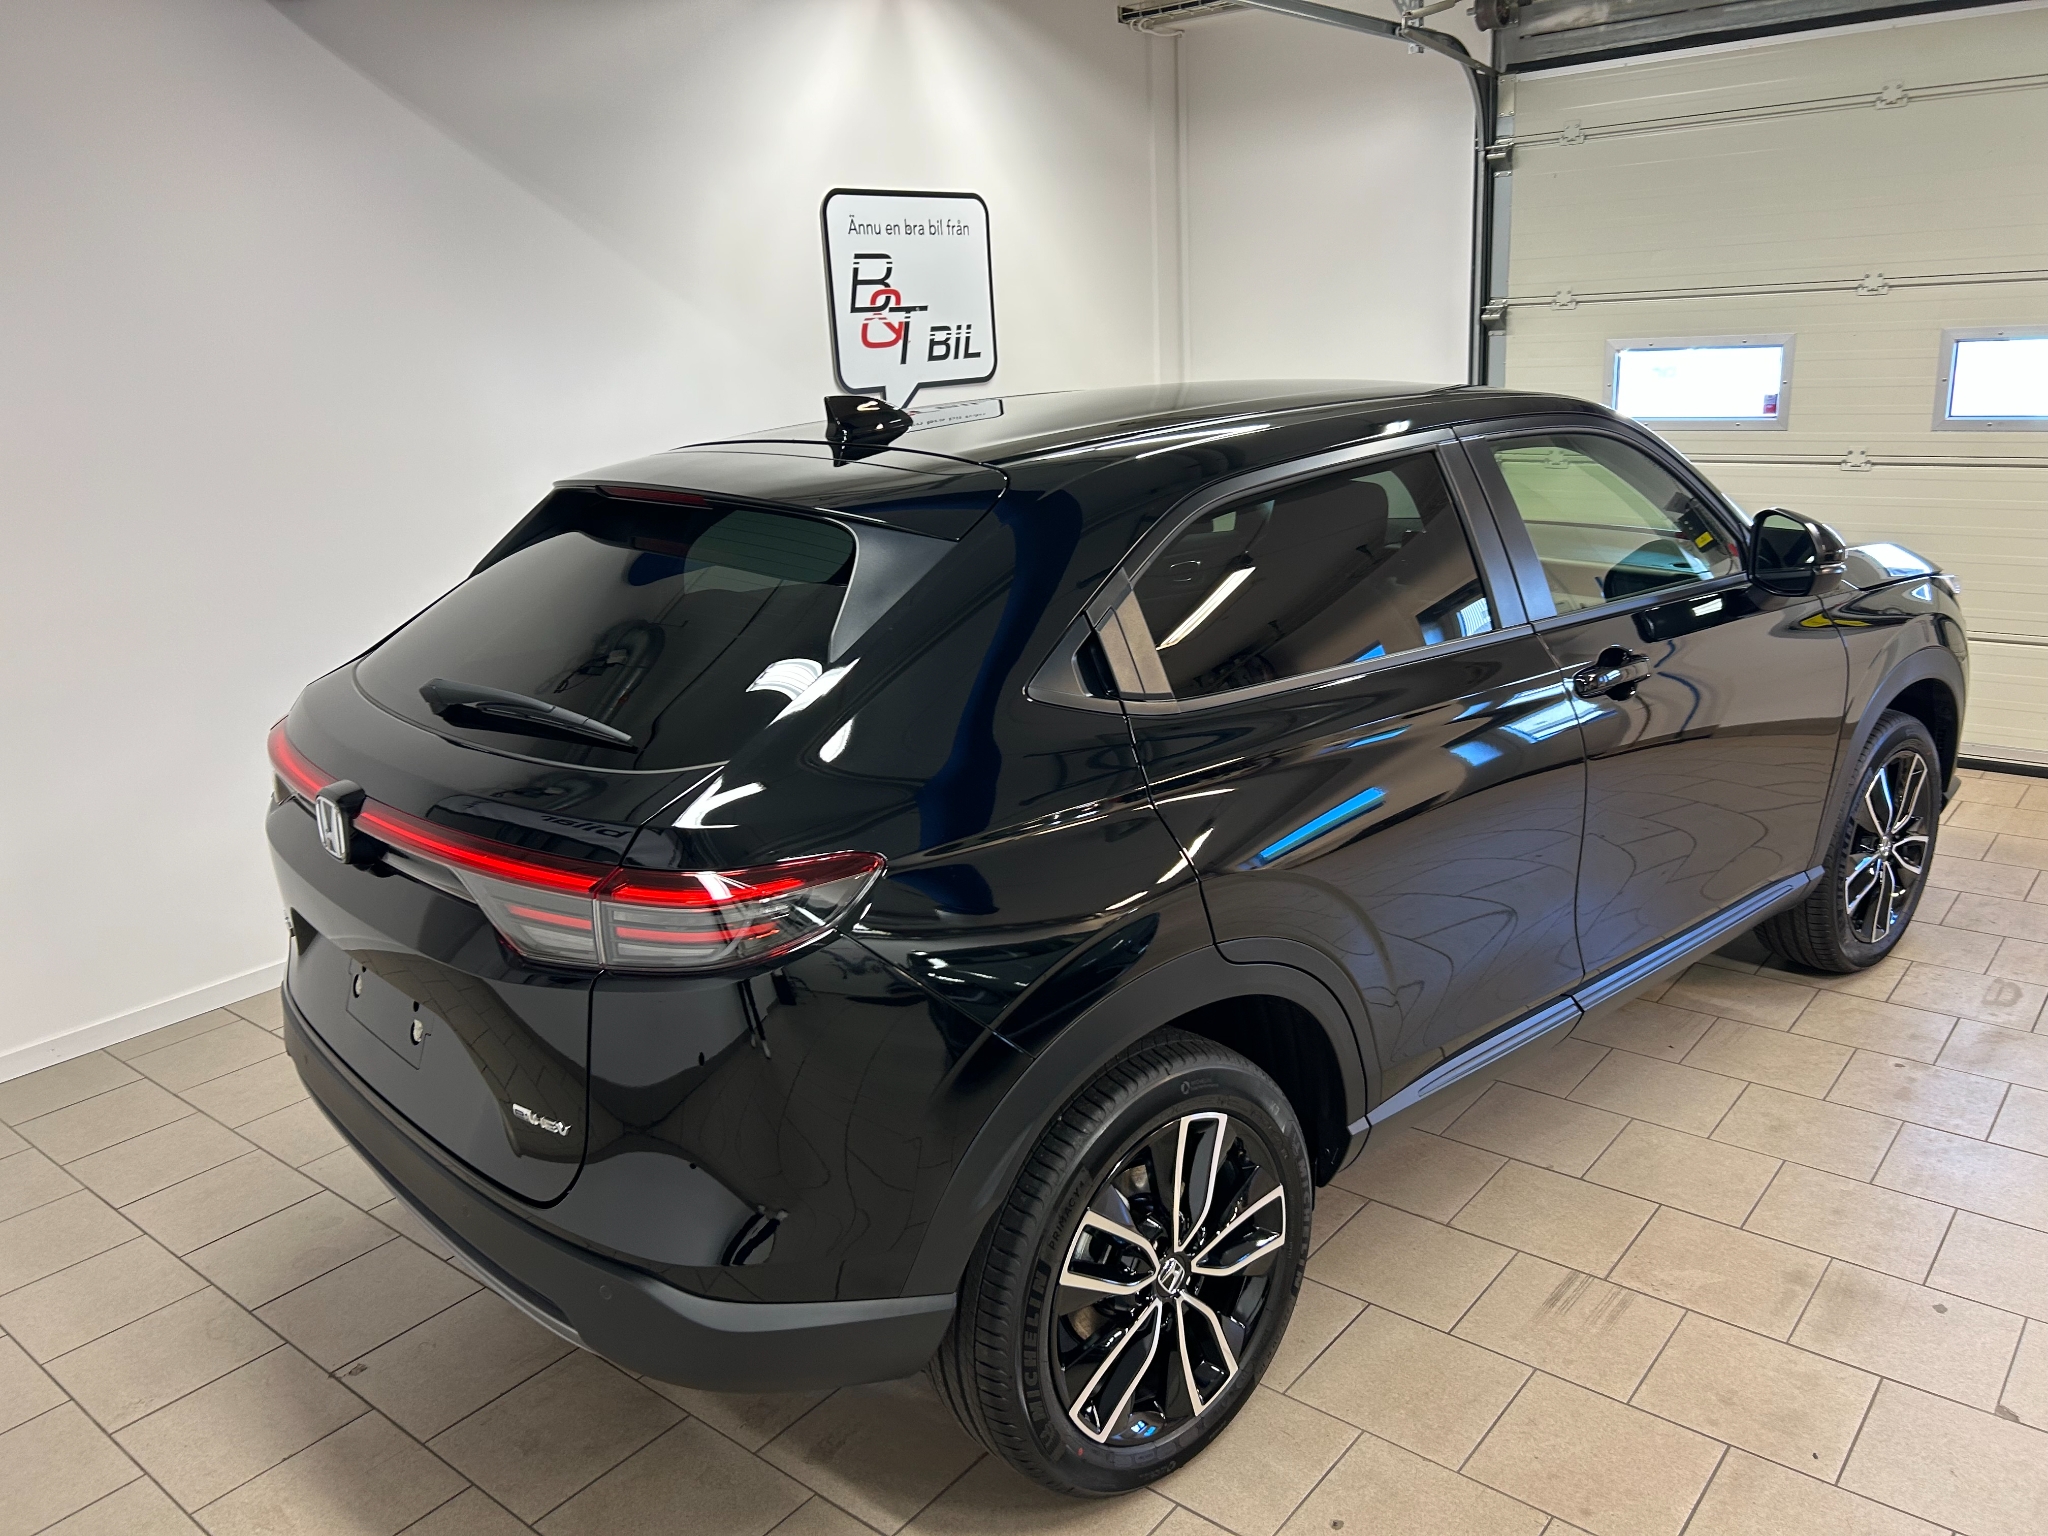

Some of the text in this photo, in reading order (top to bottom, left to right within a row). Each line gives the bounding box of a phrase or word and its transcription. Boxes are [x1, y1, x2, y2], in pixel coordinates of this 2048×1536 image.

[847, 214, 970, 236] Ännu en bra bil från
[1047, 1188, 1081, 1251] PRIMACY
[1023, 1269, 1049, 1423] MICHELIN
